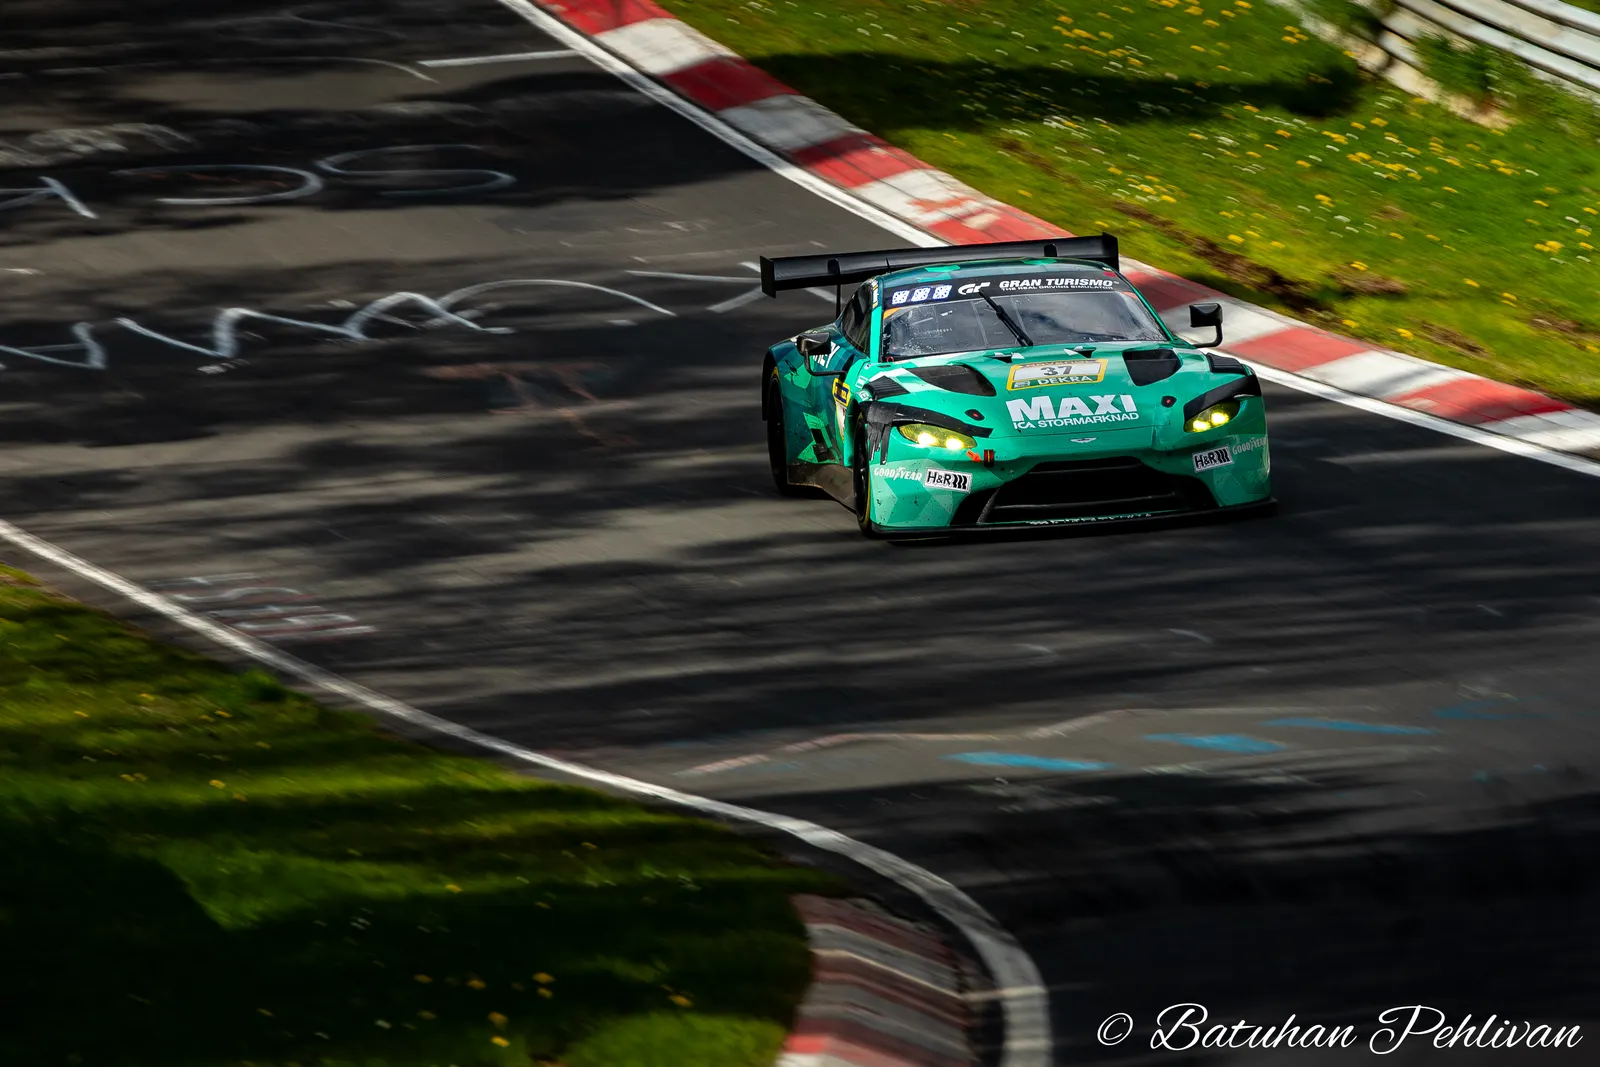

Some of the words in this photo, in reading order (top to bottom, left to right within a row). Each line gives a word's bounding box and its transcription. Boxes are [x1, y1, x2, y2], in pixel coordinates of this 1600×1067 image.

[999, 279, 1041, 288] GRAN
[1040, 365, 1073, 376] 37
[1037, 375, 1093, 385] DEKRA
[1005, 394, 1138, 422] MAXI
[1013, 421, 1036, 430] ICA
[1037, 412, 1140, 428] STORMARKNAD
[1194, 452, 1217, 469] H&R
[873, 467, 923, 481] GOODYEAR
[927, 471, 951, 486] H&R
